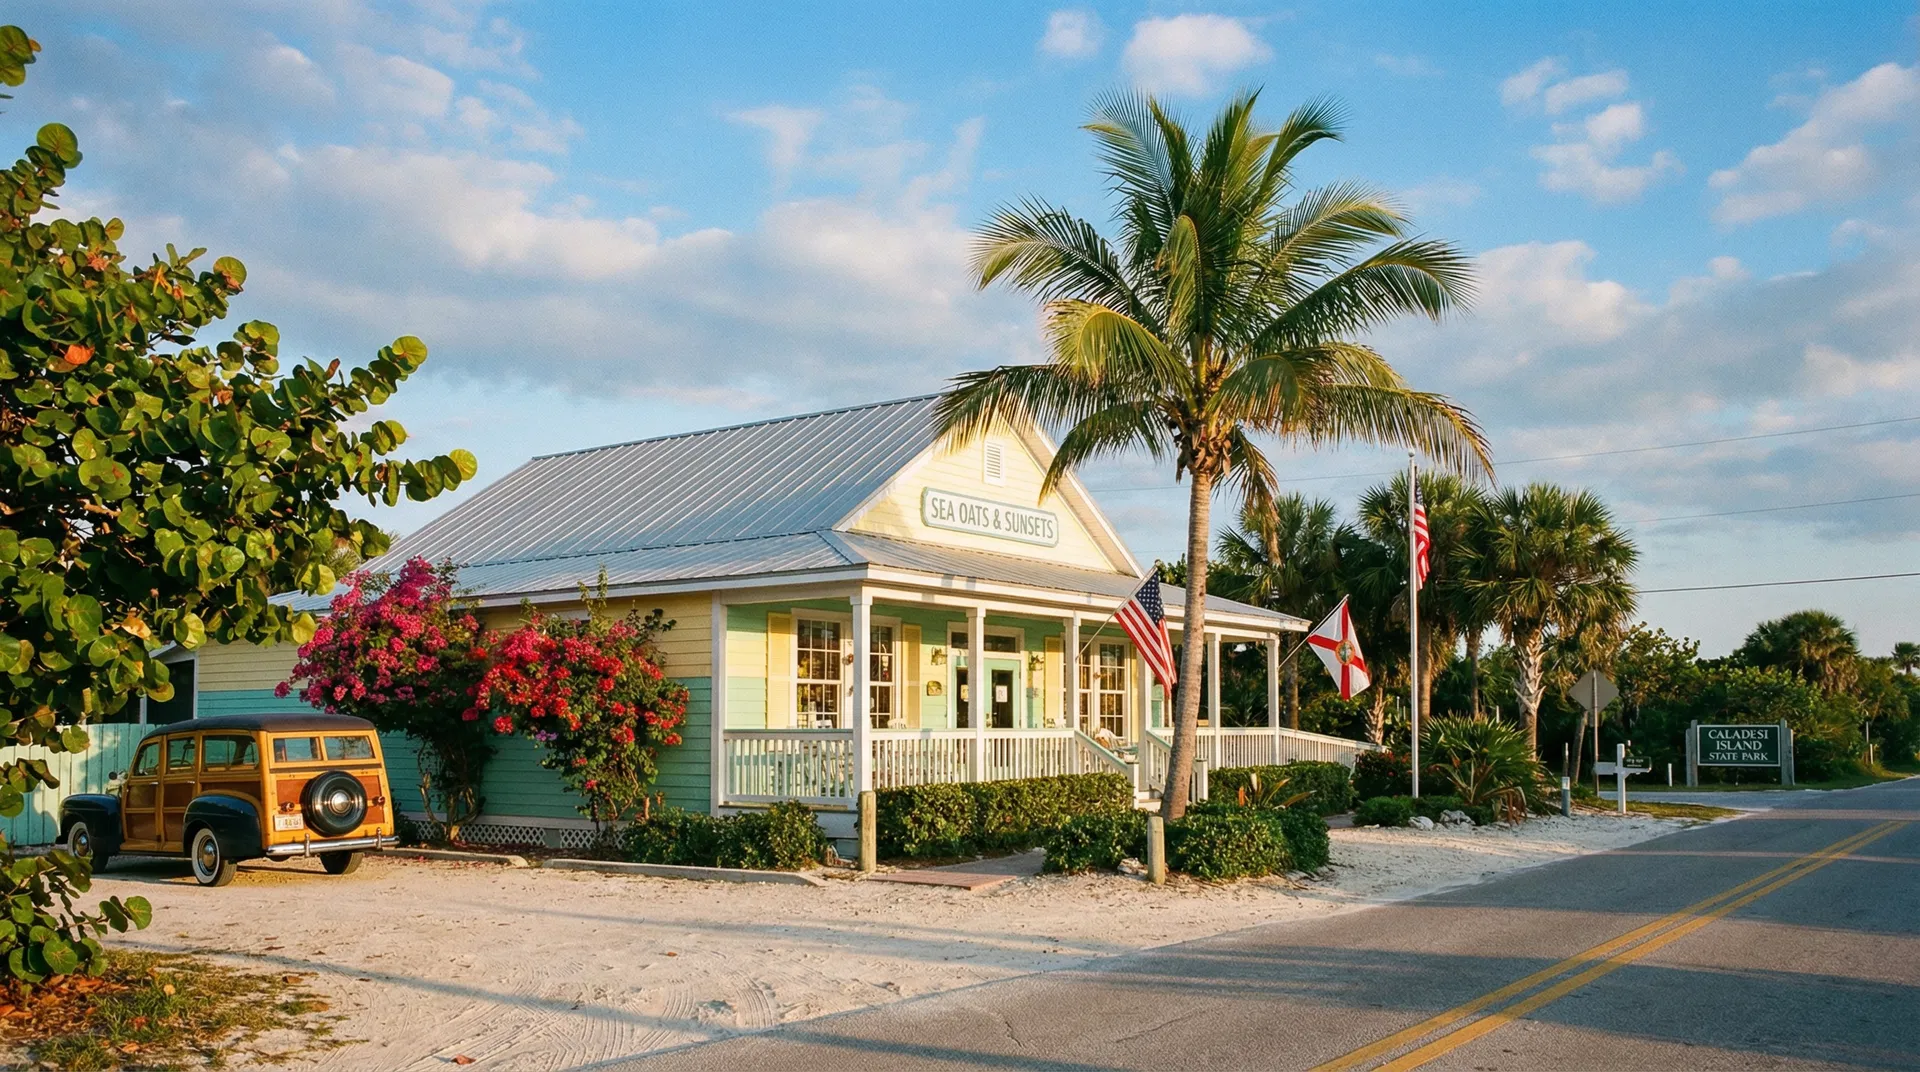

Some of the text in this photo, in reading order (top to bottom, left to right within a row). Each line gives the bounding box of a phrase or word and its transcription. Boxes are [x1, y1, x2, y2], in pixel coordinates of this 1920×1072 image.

[931, 497, 1054, 539] SEA OATS & SUNSETS
[1708, 729, 1769, 739] CALADESI
[1716, 740, 1762, 750] ISLAND
[1709, 752, 1768, 760] STATE PARK
